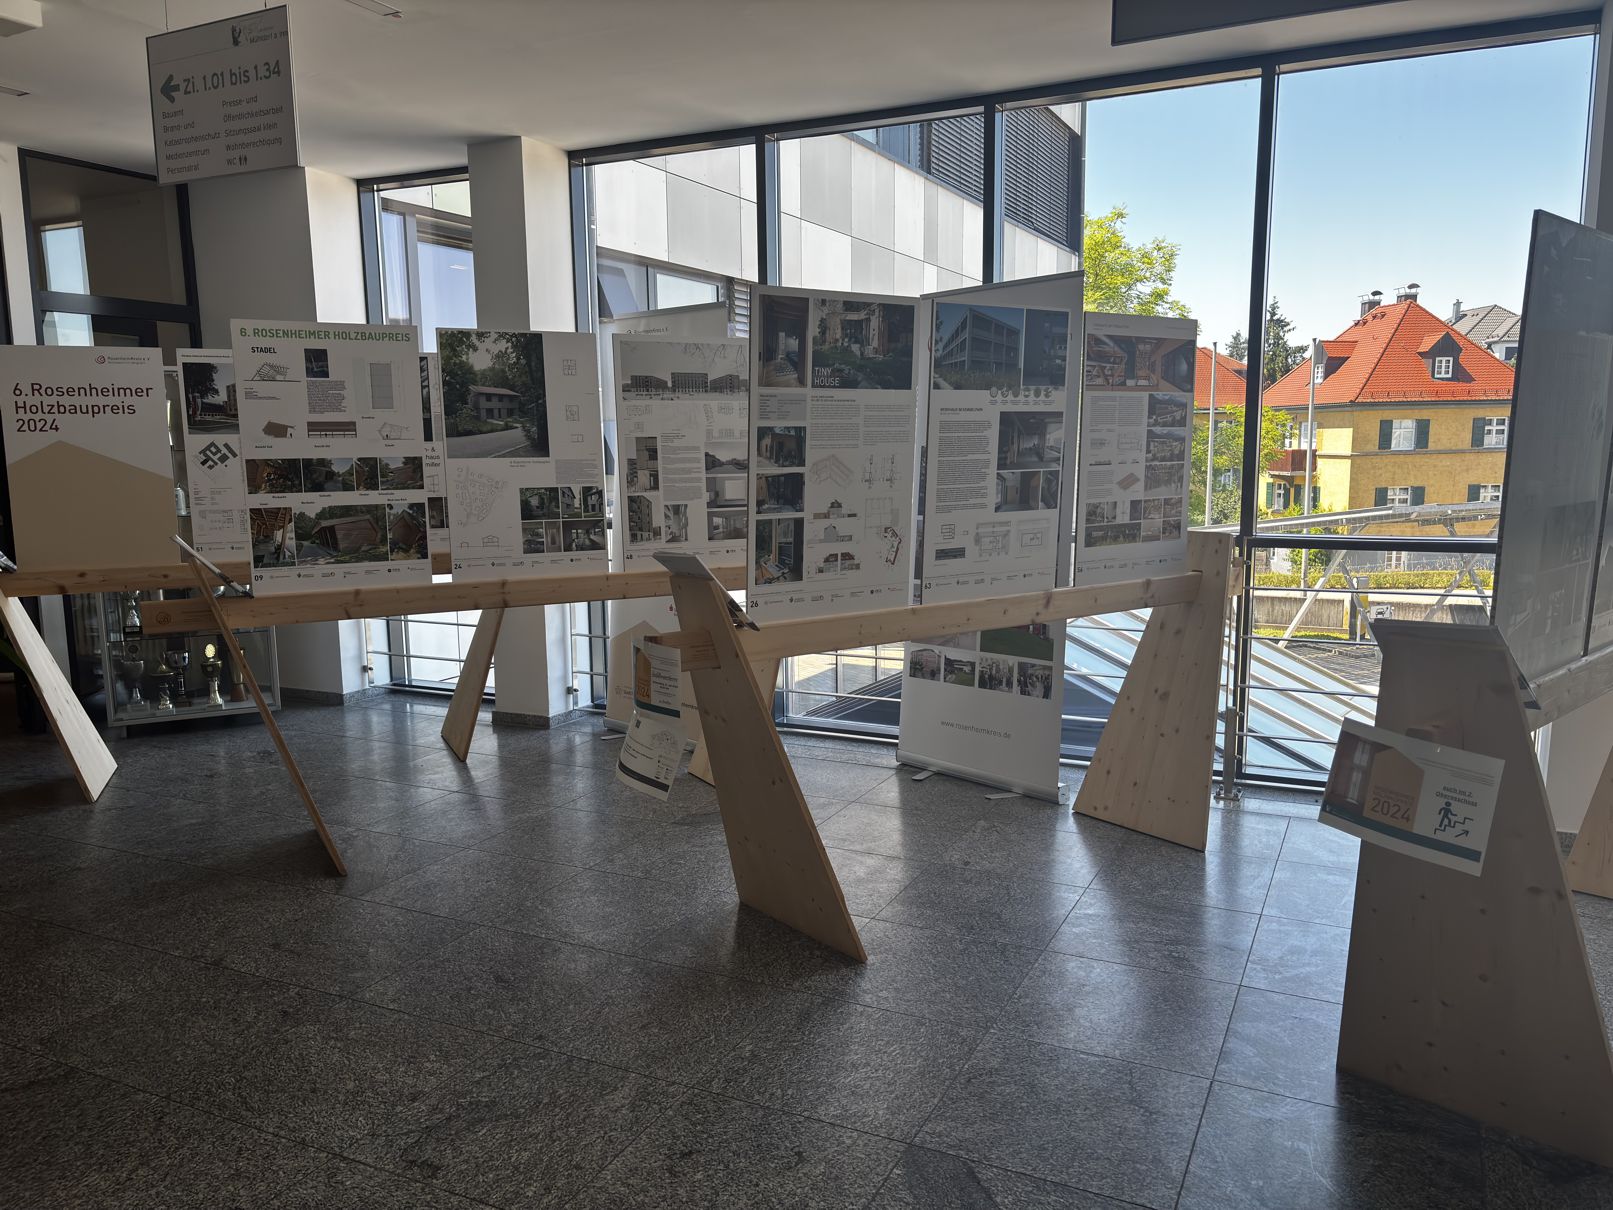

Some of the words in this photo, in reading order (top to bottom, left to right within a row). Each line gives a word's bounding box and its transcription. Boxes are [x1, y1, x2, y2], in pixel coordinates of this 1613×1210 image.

[183, 76, 199, 95] Zi.
[202, 71, 225, 92] 1.01
[229, 67, 250, 86] bis
[254, 60, 281, 81] 1.34
[221, 98, 245, 108] Presse-
[245, 95, 258, 104] und
[162, 109, 184, 120] Bauamt
[183, 121, 195, 130] und
[224, 126, 261, 139] Sitzungssaal
[262, 122, 278, 132] klein
[164, 132, 221, 148] Katastrophenschutz
[225, 135, 283, 152] Wohnberechtigung
[165, 148, 210, 161] Medienzentrum
[167, 162, 200, 174] Personalrat
[226, 157, 237, 166] WC
[239, 327, 250, 337] 6.
[253, 328, 331, 341] ROSENHEIMER
[333, 331, 411, 342] HOLZBAUPREIS
[251, 346, 277, 354] STADEL
[814, 367, 832, 376] TINY
[814, 377, 840, 386] HOUSE
[14, 400, 137, 418] Holzbaupreis
[16, 418, 60, 433] 2024
[254, 574, 264, 582] 09
[750, 600, 759, 608] 26
[1370, 797, 1411, 823] 2024
